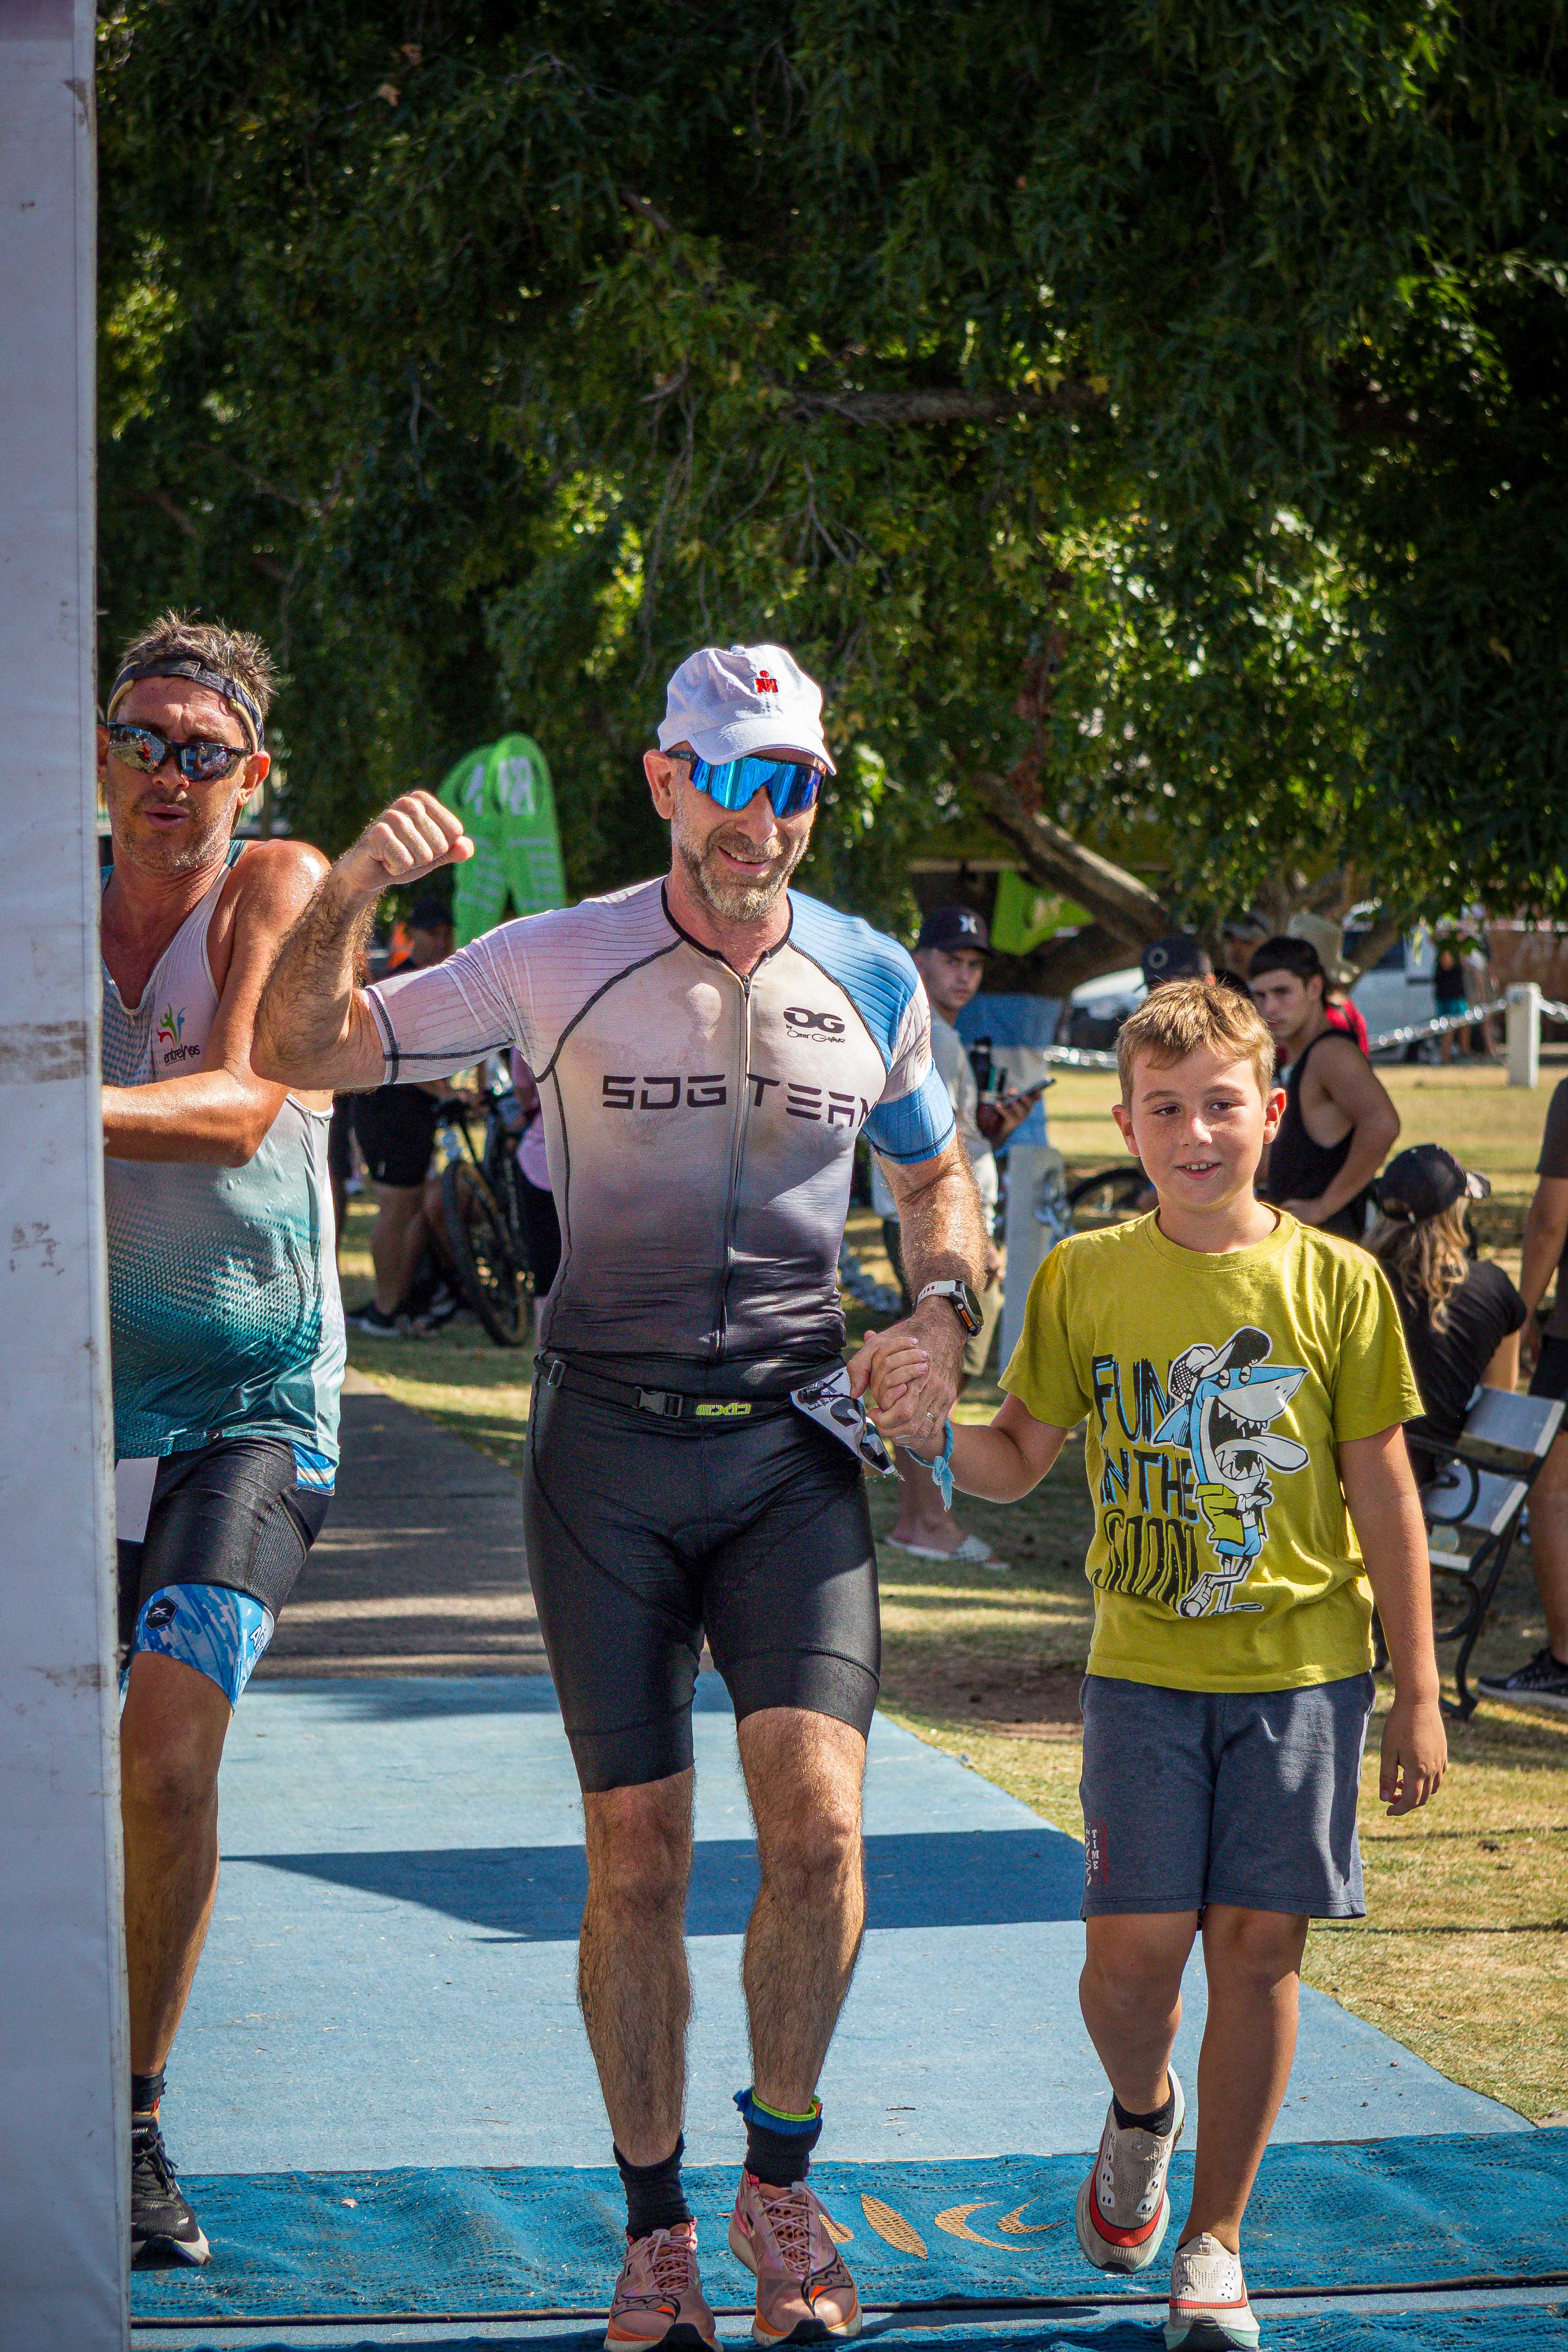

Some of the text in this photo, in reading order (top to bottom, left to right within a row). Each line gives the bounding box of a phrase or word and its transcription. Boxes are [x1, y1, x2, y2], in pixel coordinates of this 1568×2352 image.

[602, 1074, 727, 1110] SDG
[1092, 1354, 1178, 1445] FUN
[1133, 1449, 1200, 1523] THE
